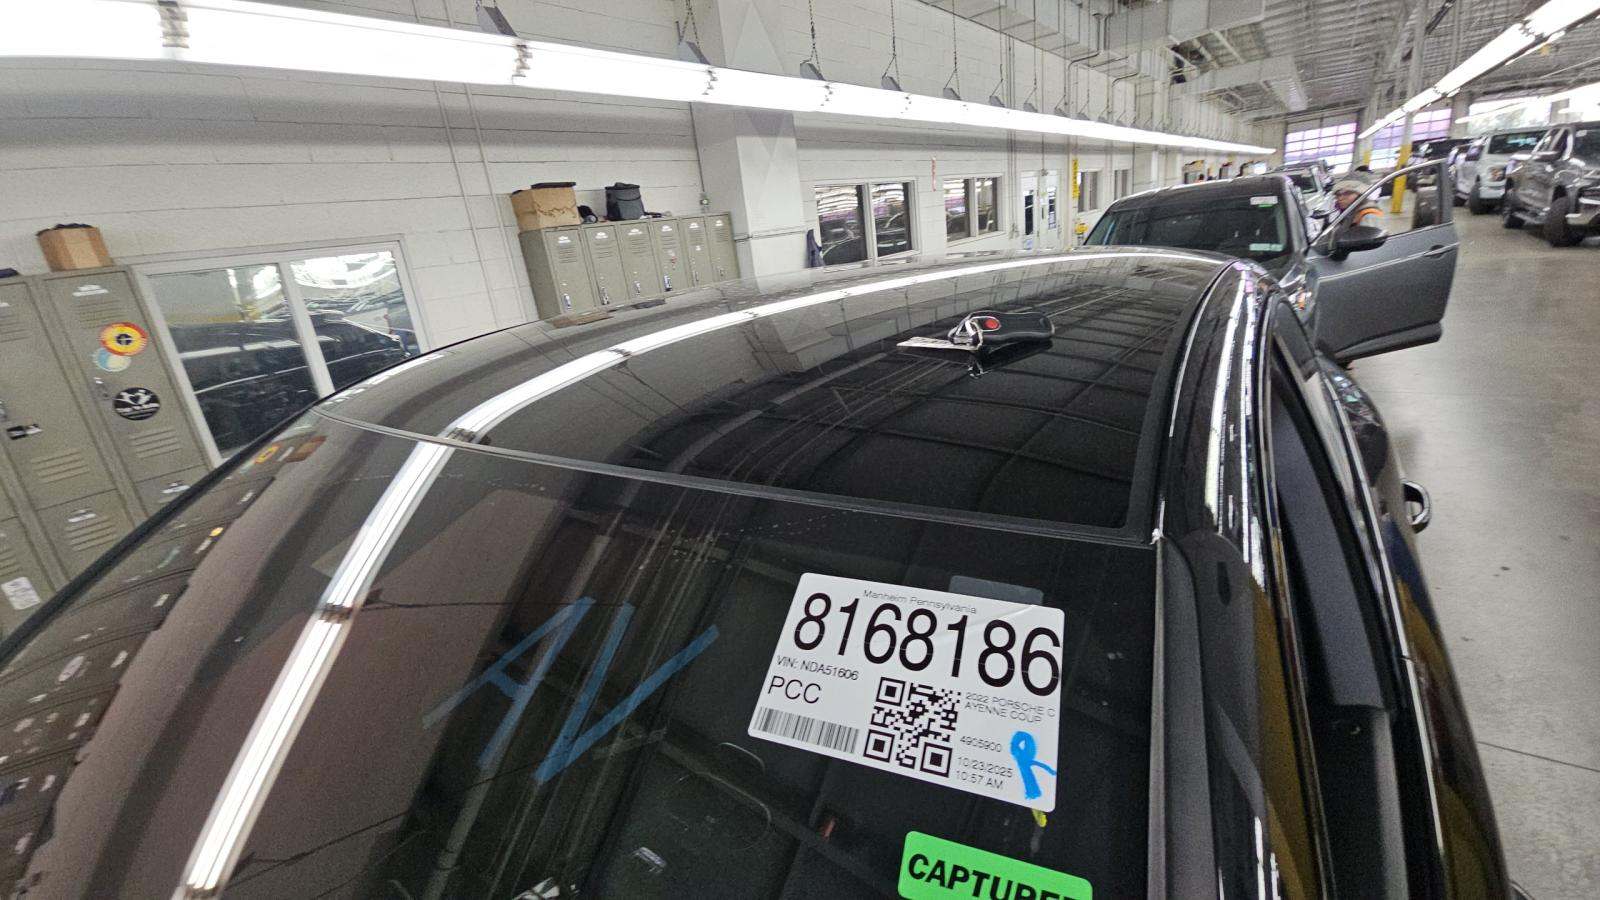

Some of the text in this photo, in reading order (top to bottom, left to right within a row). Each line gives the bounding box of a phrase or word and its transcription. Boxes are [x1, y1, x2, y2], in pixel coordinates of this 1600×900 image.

[863, 589, 977, 614] Manheim Pennsylvania
[793, 592, 1061, 697] 8168186
[777, 655, 860, 681] VIN: NDA51606
[767, 675, 821, 704] PCC
[964, 701, 1042, 723] AYENNE COUP
[965, 692, 989, 704] 2022
[992, 696, 1044, 715] PORSCHE
[957, 756, 1013, 778] 10/23/2025
[985, 777, 1004, 790] AM
[907, 853, 1082, 900] CAPTUR
